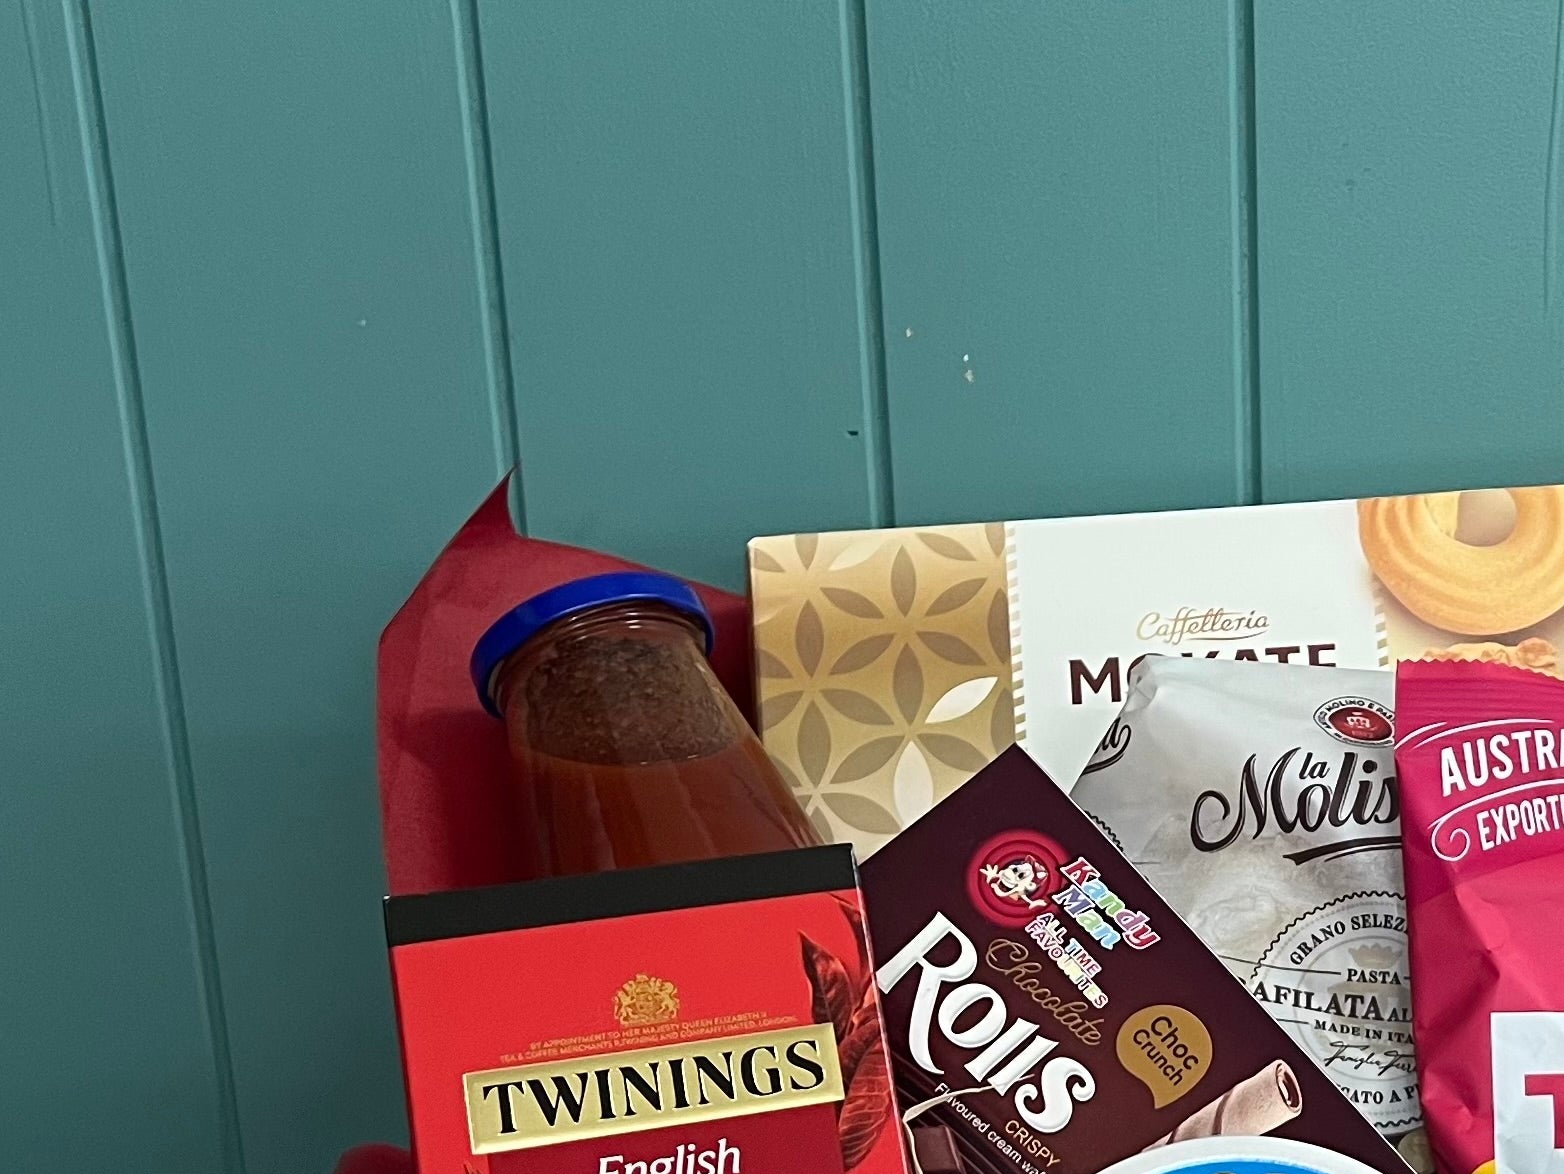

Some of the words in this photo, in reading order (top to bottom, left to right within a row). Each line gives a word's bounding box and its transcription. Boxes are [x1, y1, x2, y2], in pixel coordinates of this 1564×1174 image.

[1300, 751, 1330, 781] la
[1052, 884, 1121, 950] Man
[1060, 857, 1161, 950] Kandy
[1025, 918, 1109, 1009] FAVOURITES
[1036, 913, 1068, 945] ALL
[1065, 938, 1103, 979] TIME
[1289, 920, 1346, 966] GRANO
[986, 938, 1105, 1046] Chocolate
[1346, 968, 1401, 985] PASTA
[1132, 1028, 1187, 1087] Crunch
[1150, 1016, 1199, 1071] Choc
[1314, 1019, 1361, 1037] MADE
[1365, 1028, 1383, 1041] IN
[482, 1039, 824, 1136] TWININGS
[1389, 1089, 1402, 1104] A
[987, 1131, 1022, 1164] cream
[1005, 1119, 1061, 1168] CRISPY
